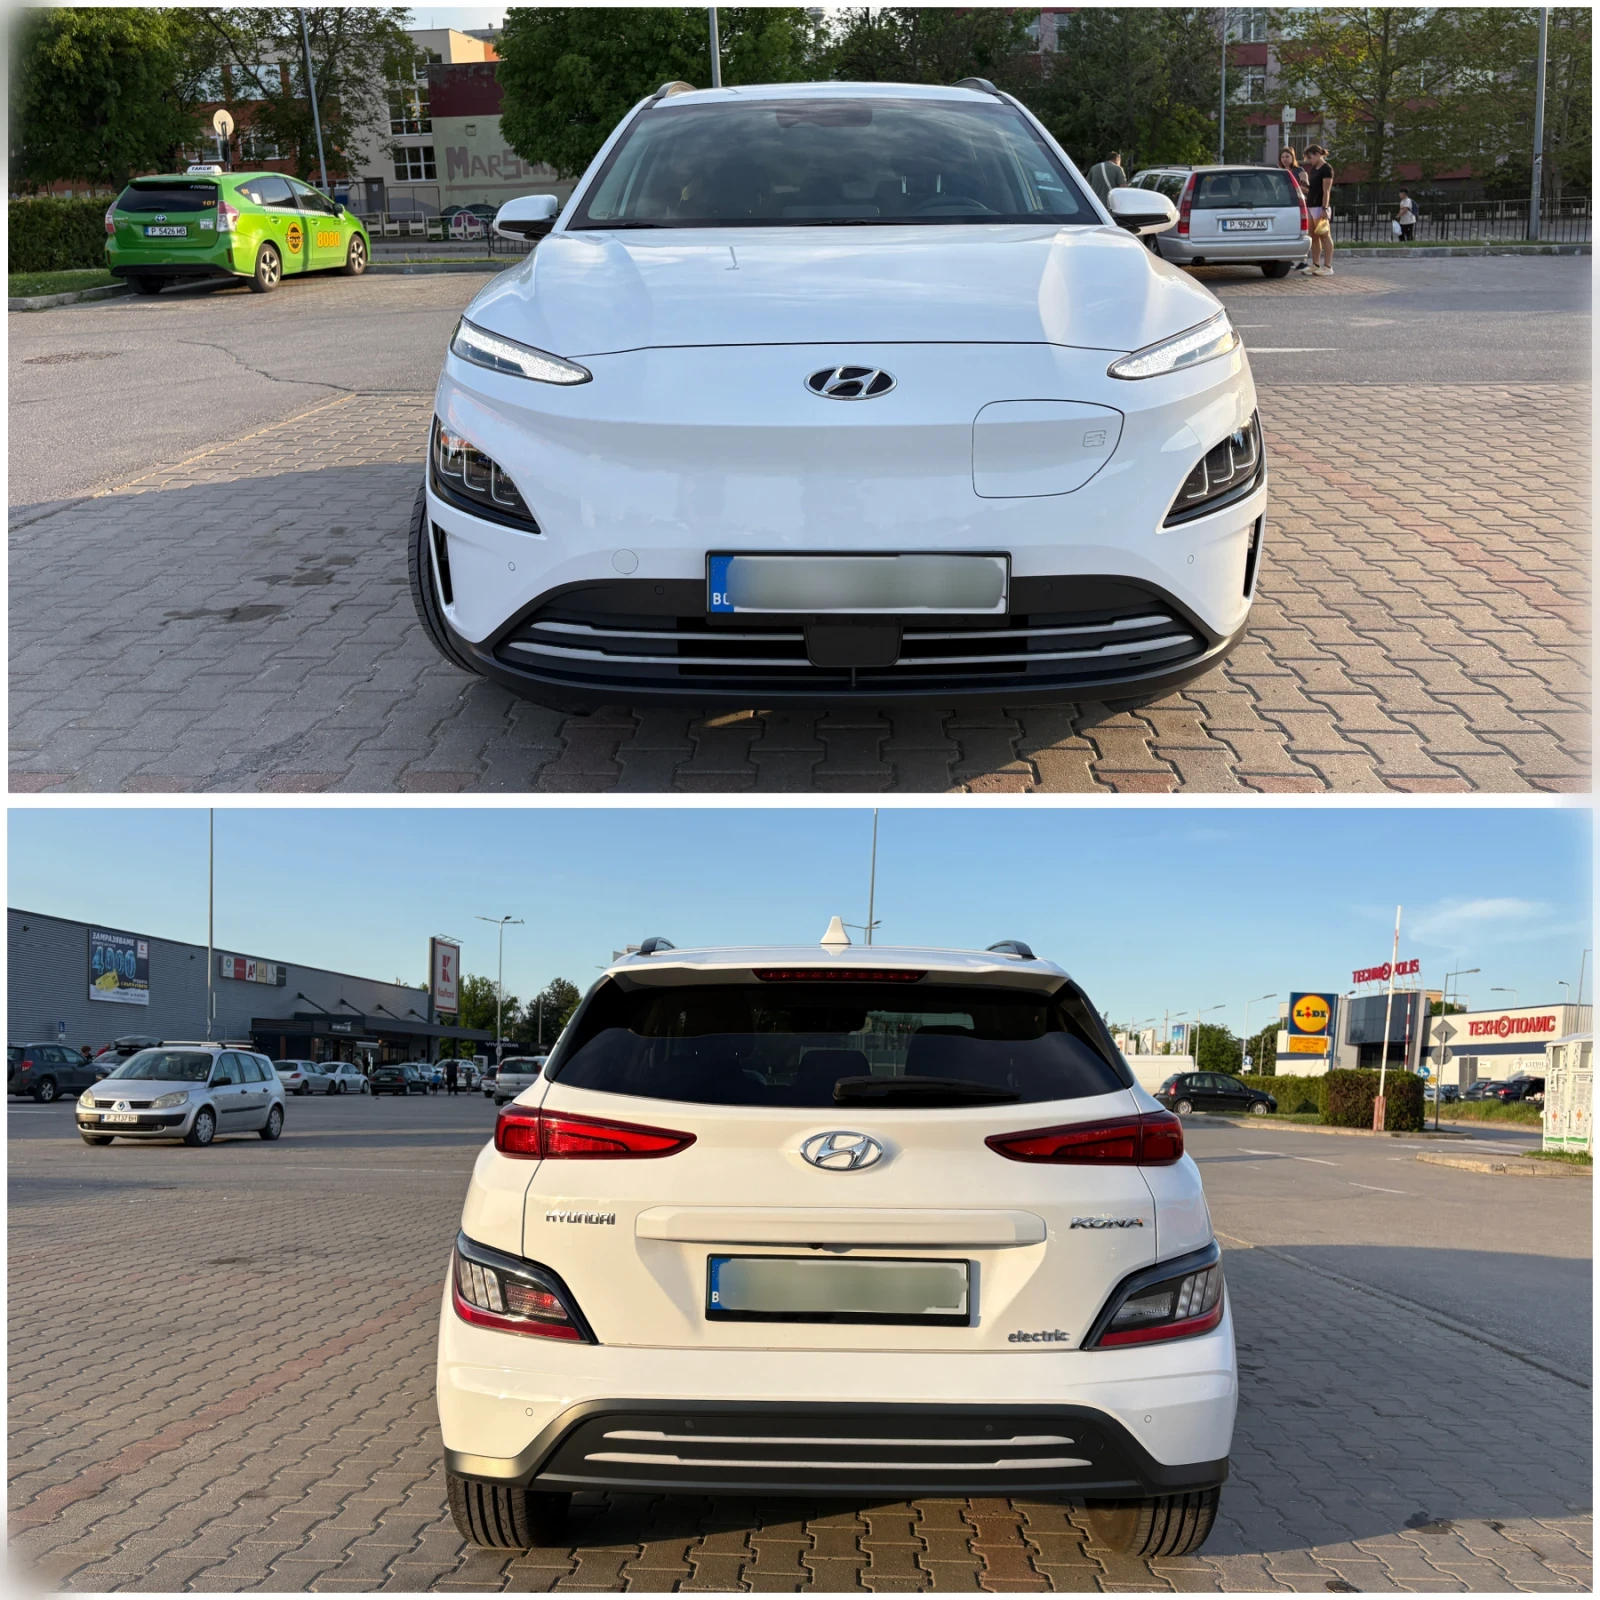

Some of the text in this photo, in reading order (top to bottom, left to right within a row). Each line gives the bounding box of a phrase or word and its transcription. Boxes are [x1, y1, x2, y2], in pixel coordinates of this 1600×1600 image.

[159, 227, 176, 235] 5426
[1238, 221, 1255, 229] 9627
[317, 231, 340, 247] 8080
[92, 932, 135, 946] ЗАМРАЗЯВАМЕ
[92, 946, 137, 979] 4000
[1468, 1015, 1556, 1038] ТЕХНОПОЛИС
[545, 1210, 616, 1225] HYUNDAI
[1069, 1217, 1144, 1229] KONA
[1008, 1329, 1071, 1343] electric
